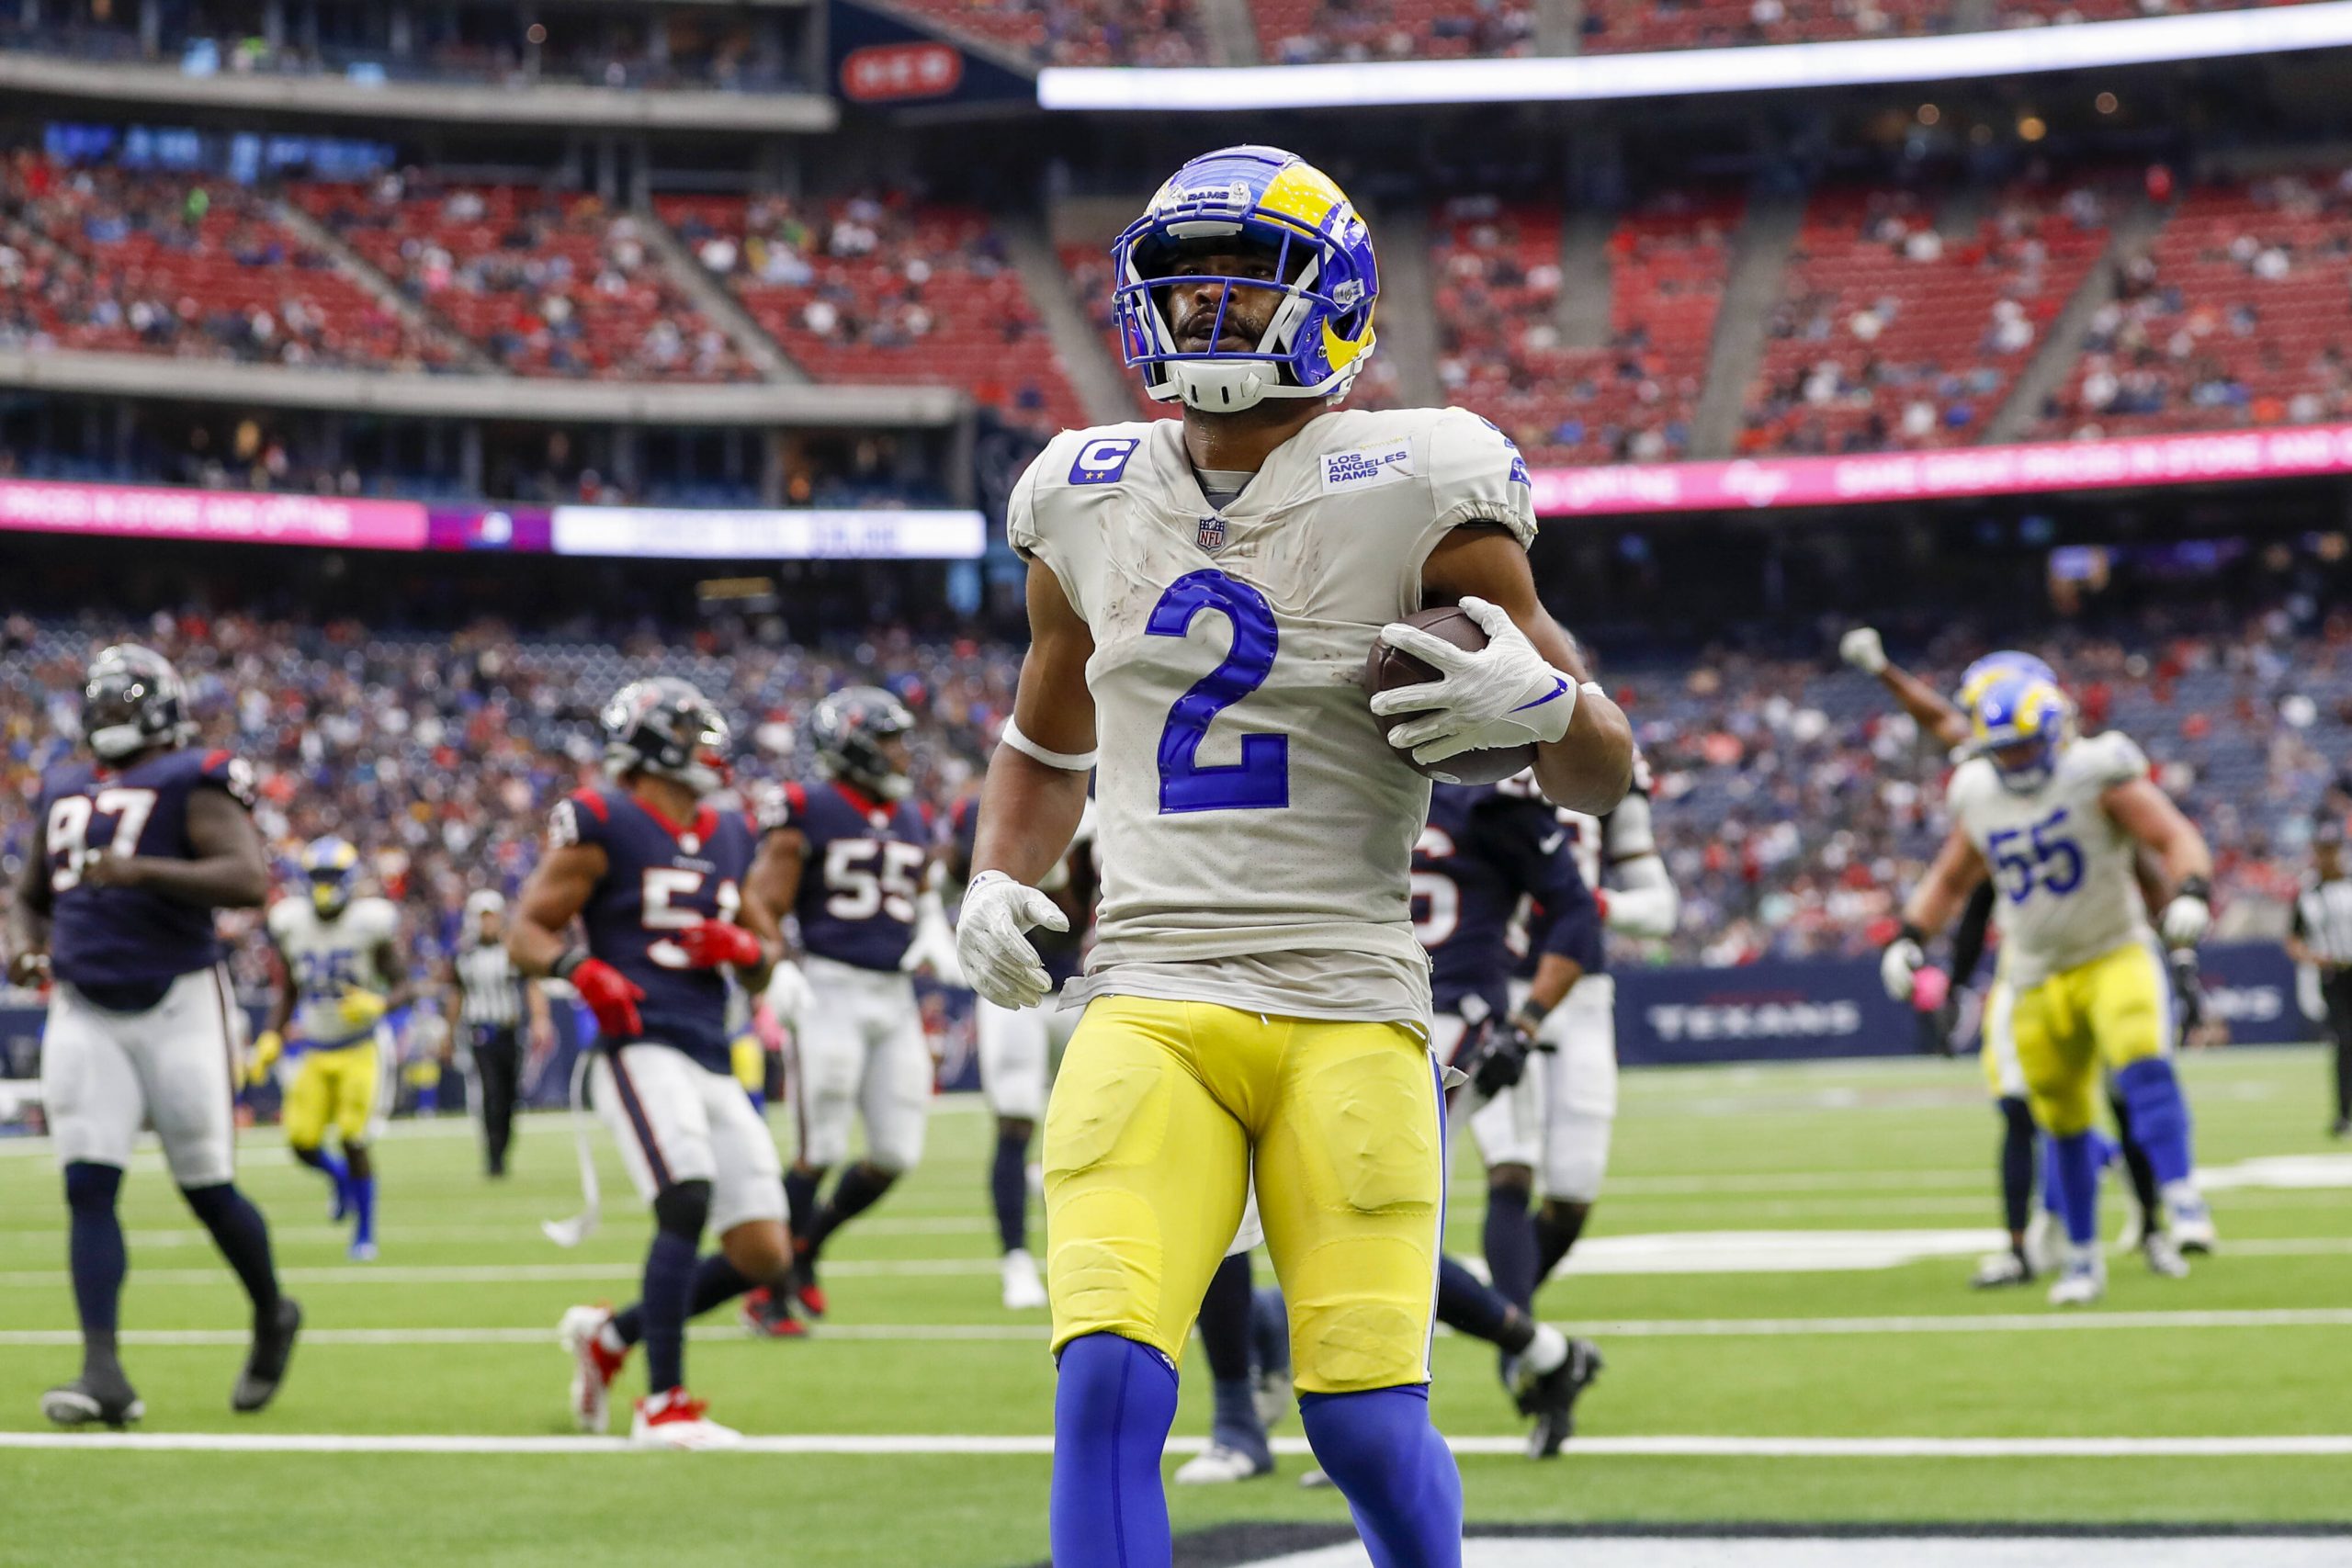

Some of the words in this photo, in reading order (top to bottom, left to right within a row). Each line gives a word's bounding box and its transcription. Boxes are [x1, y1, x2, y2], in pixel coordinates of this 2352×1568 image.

[1187, 191, 1229, 201] RAMS
[1079, 440, 1132, 470] C
[1328, 454, 1361, 466] LOS
[1329, 451, 1408, 474] ANGELES
[1329, 468, 1378, 483] RAMS
[1200, 530, 1222, 547] NFL
[1145, 569, 1289, 815] 2
[47, 788, 158, 892] 97
[1988, 808, 2086, 906] 55
[825, 838, 924, 922] 55
[1648, 1001, 1860, 1041] TEXANS
